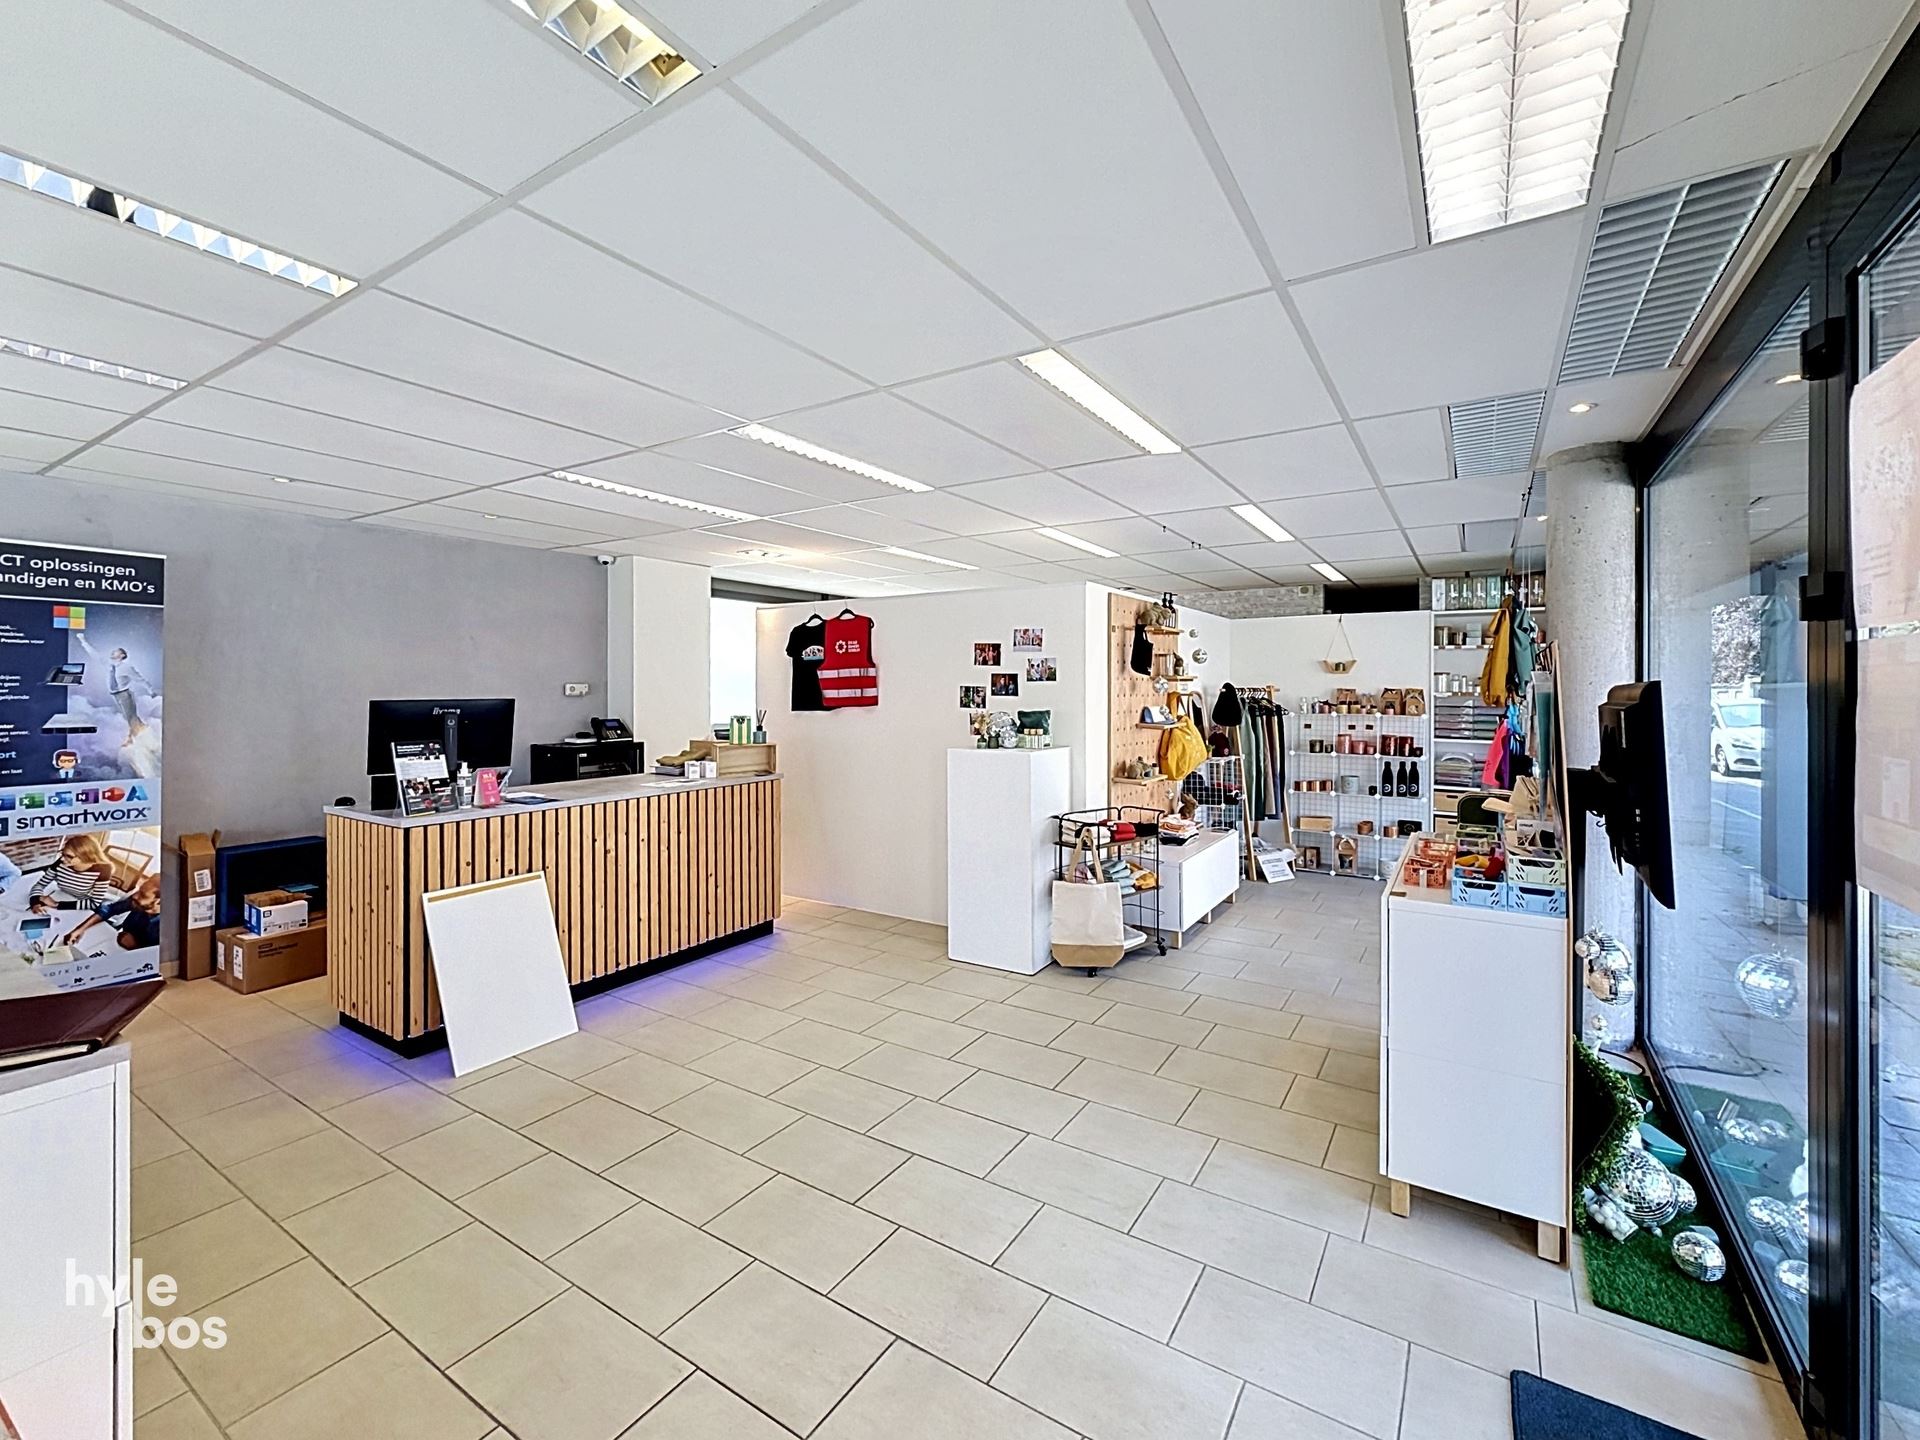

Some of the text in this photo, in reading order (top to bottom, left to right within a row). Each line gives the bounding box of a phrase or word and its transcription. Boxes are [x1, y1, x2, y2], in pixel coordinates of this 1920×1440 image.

[30, 558, 136, 577] oplossingen
[74, 579, 96, 589] en
[101, 579, 156, 593] KMO's
[16, 807, 148, 830] smartworx
